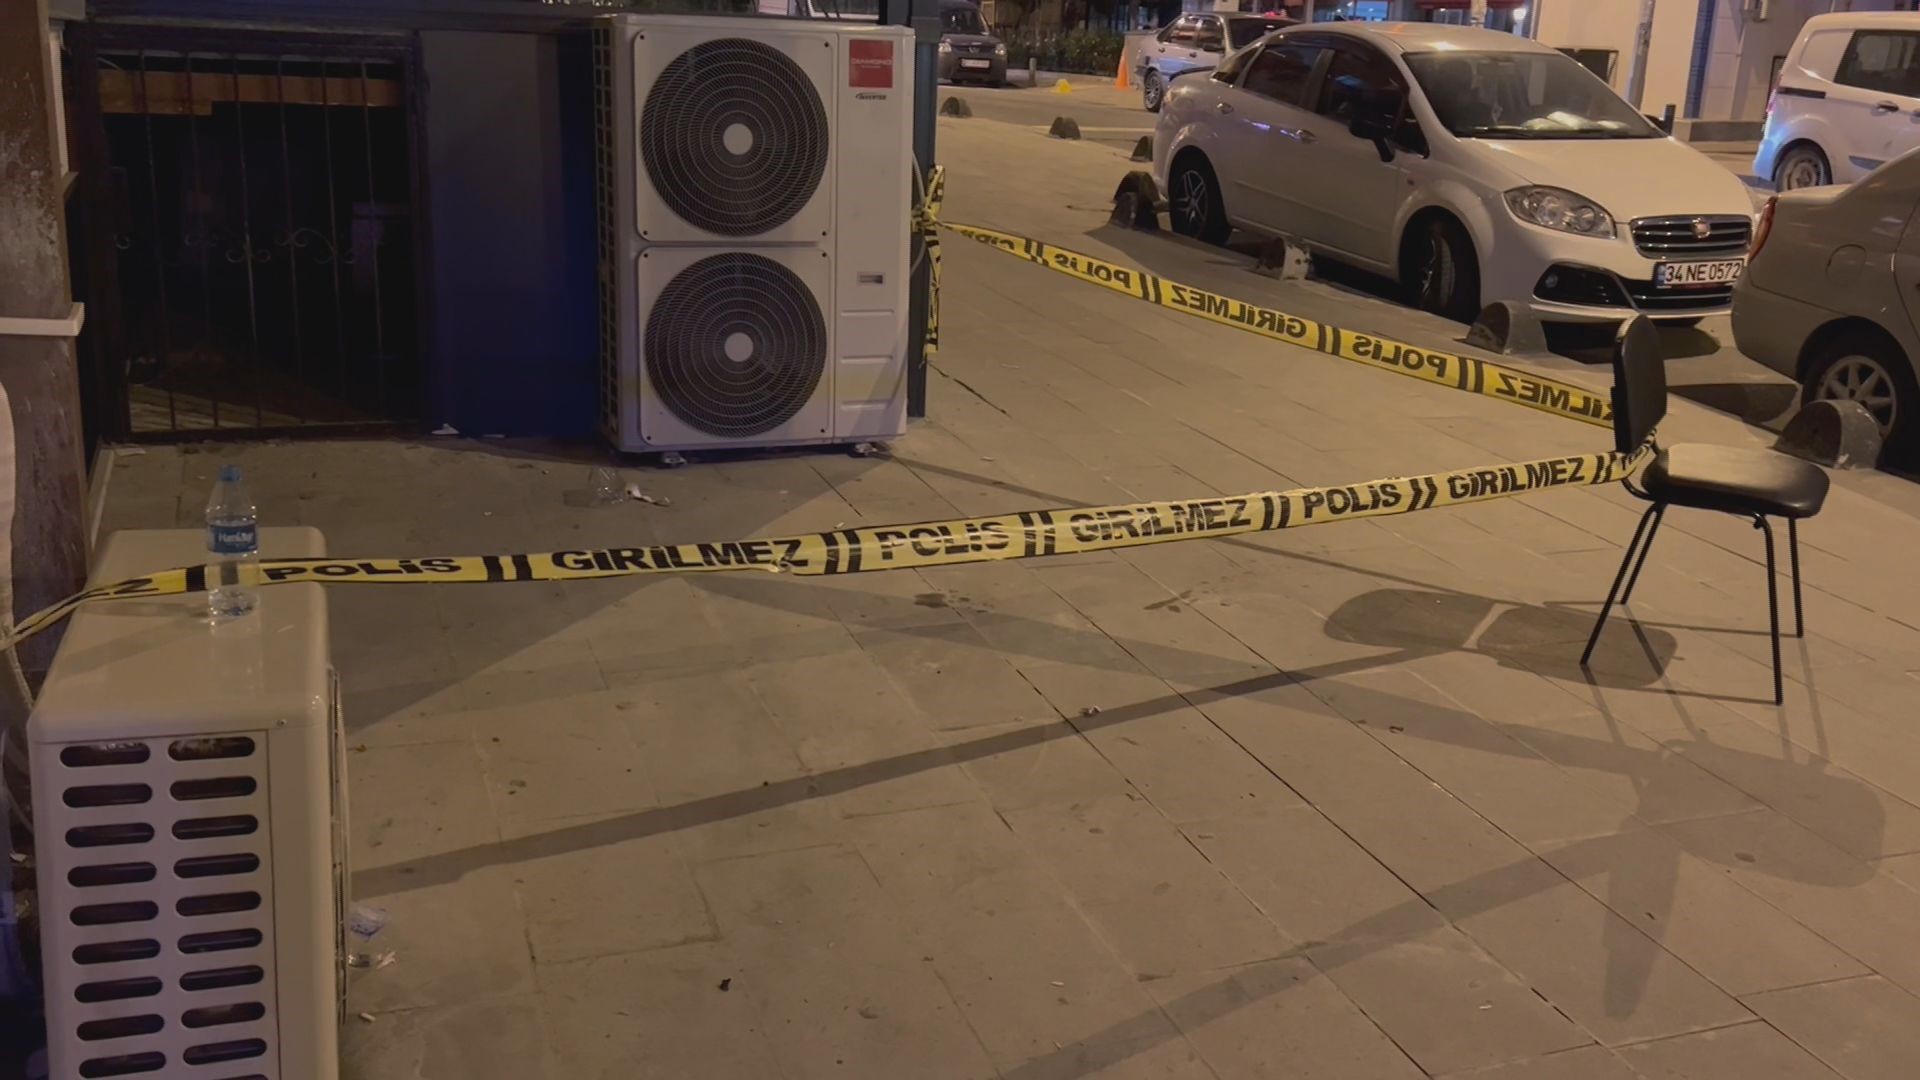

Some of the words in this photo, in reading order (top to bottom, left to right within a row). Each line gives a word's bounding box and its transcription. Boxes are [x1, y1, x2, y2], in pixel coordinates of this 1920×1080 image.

[1666, 265, 1682, 282] 34
[1686, 264, 1708, 281] NE
[1709, 262, 1741, 279] 0572
